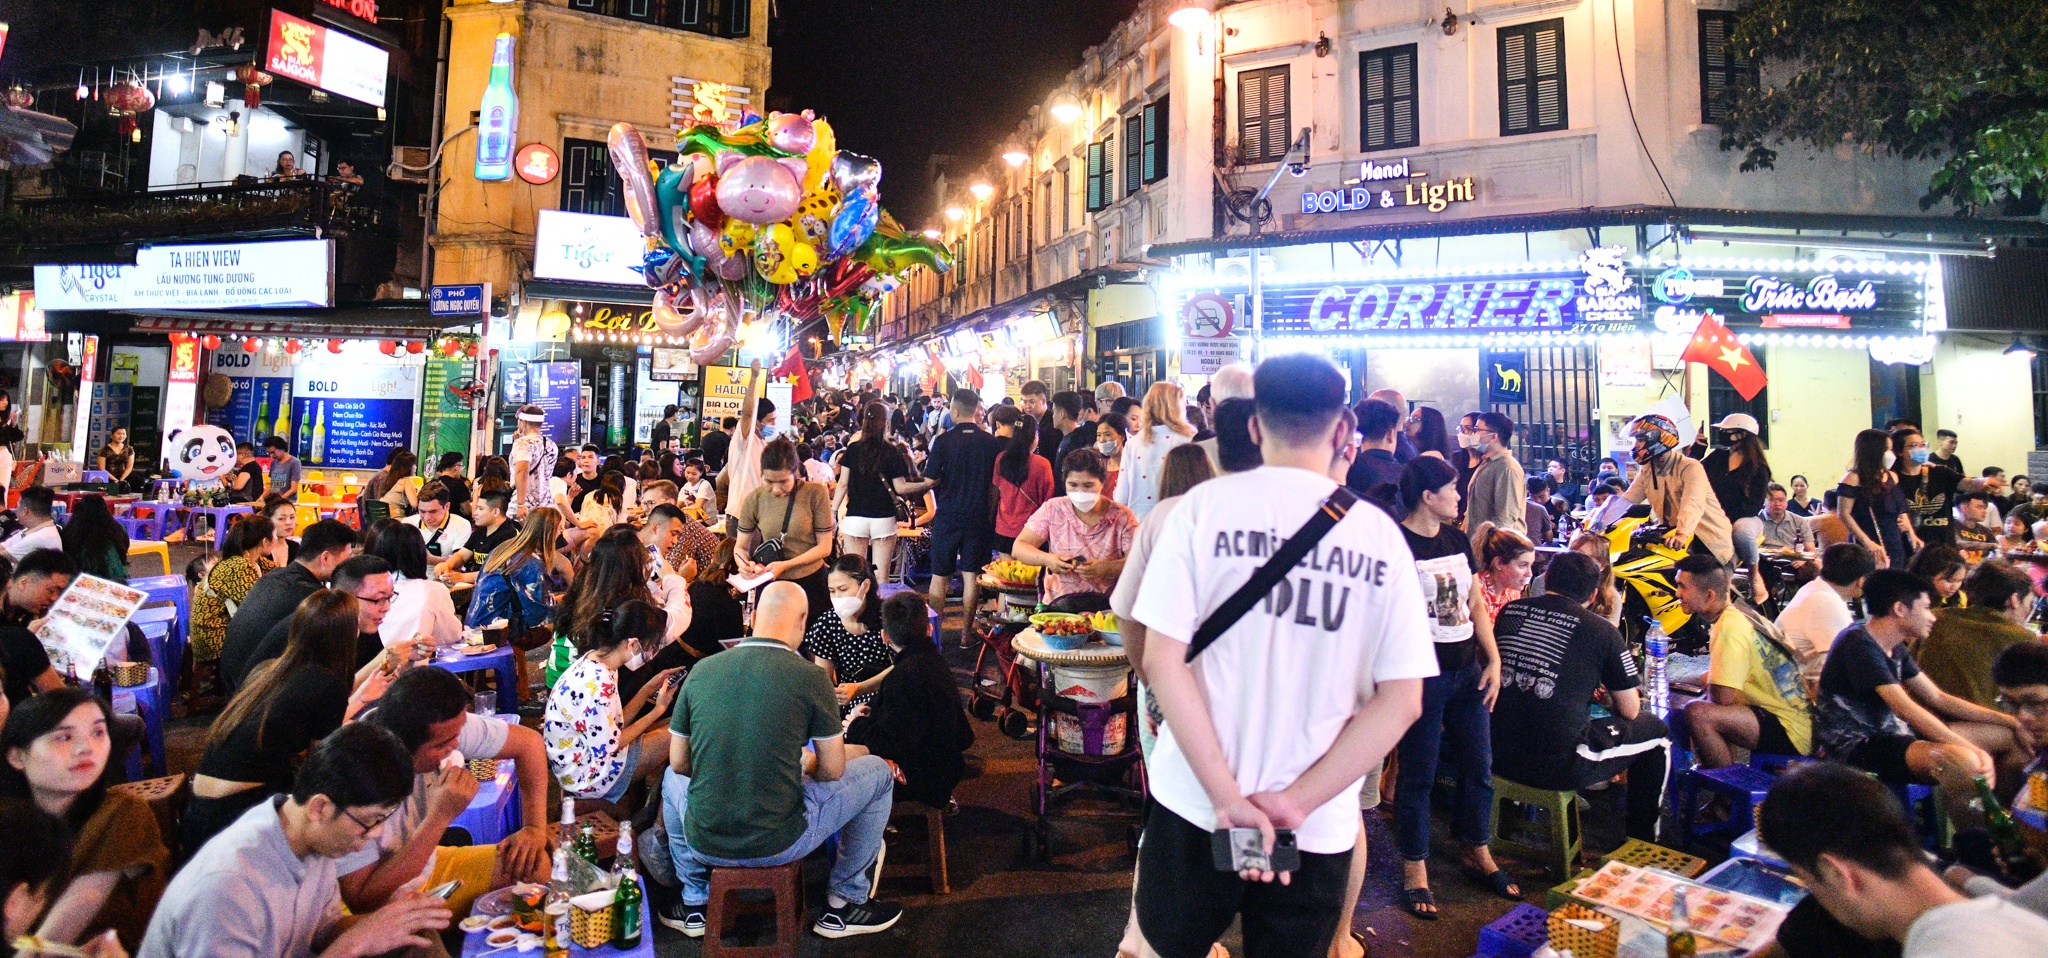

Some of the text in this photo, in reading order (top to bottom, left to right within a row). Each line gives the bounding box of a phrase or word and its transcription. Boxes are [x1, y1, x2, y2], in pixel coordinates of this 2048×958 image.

[271, 57, 317, 82] SAIGON
[701, 115, 716, 123] BIA
[1302, 177, 1476, 214] BOLD & Light
[170, 250, 241, 268] TA HIEN VIEW
[562, 244, 614, 268] Tiger
[186, 289, 198, 297] BIA
[448, 288, 466, 297] PHỐ
[1744, 274, 1877, 314] Trúc Bạch
[85, 294, 118, 303] CRYSTAL
[1576, 295, 1642, 312] SAIGON
[1309, 279, 1576, 332] CORNER
[1585, 311, 1635, 321] CHILL
[1572, 323, 1588, 333] 27
[217, 354, 250, 367] BOLD
[170, 371, 196, 380] SAIGON
[308, 380, 397, 396] BOLD Light
[715, 384, 748, 395] HALID
[706, 400, 721, 408] BIA
[1923, 516, 1949, 527] das
[1530, 607, 1547, 615] THE
[1529, 613, 1546, 622] THE
[1547, 617, 1577, 629] FIGHT
